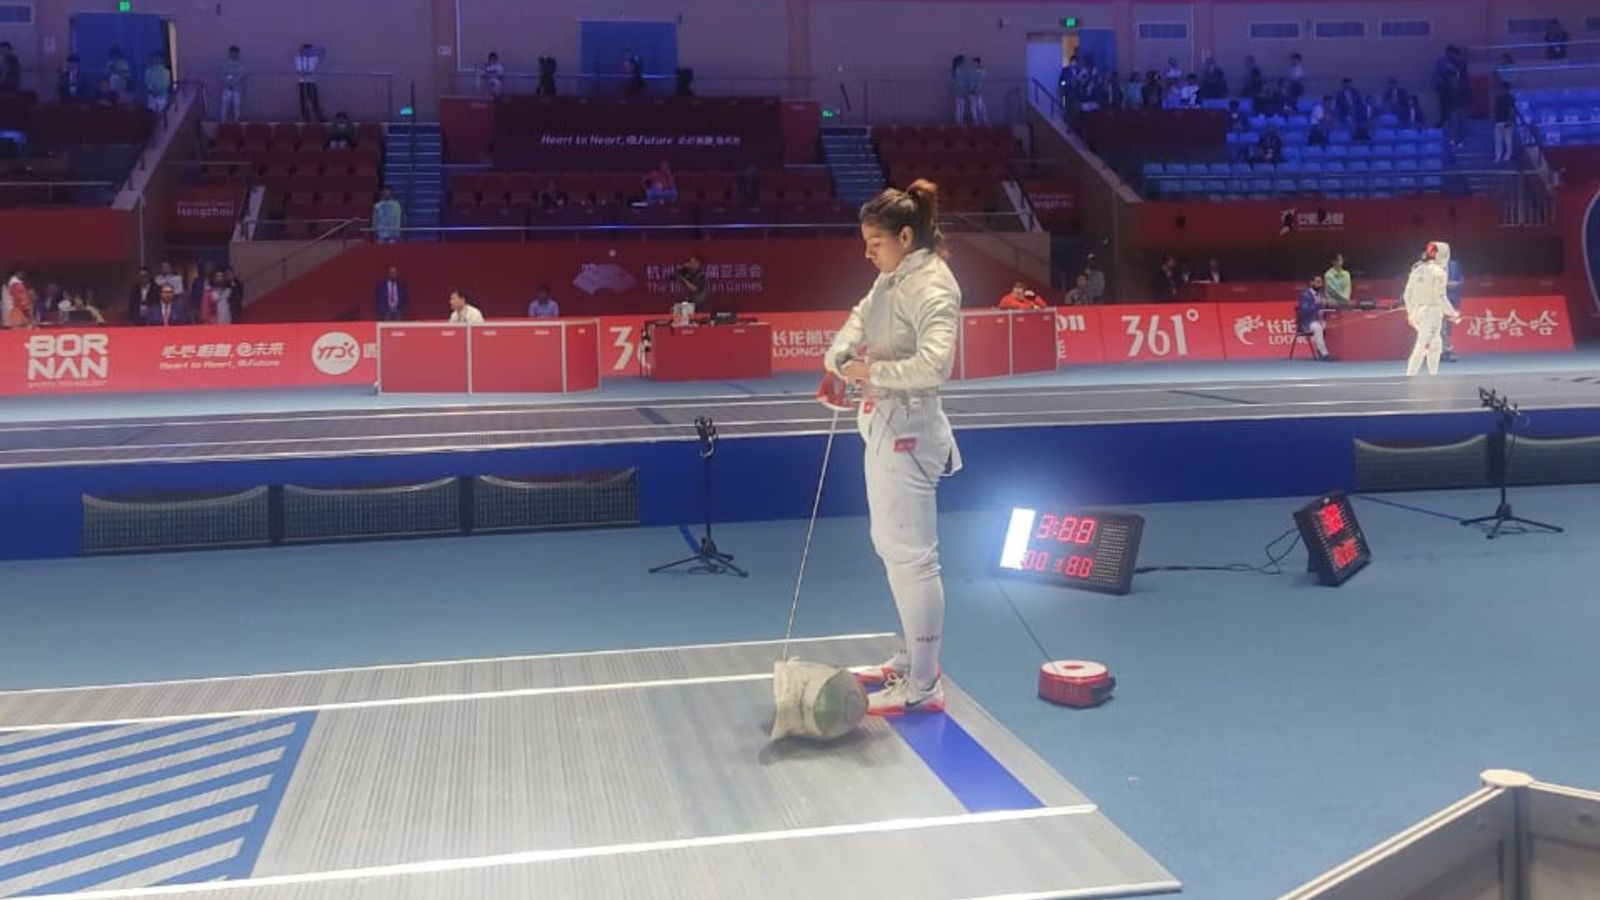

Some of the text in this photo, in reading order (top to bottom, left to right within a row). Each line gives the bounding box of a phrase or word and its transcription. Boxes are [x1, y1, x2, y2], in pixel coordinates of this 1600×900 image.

[1467, 308, 1560, 340] 娃哈哈
[28, 333, 109, 357] BOR
[27, 356, 108, 380] NAN
